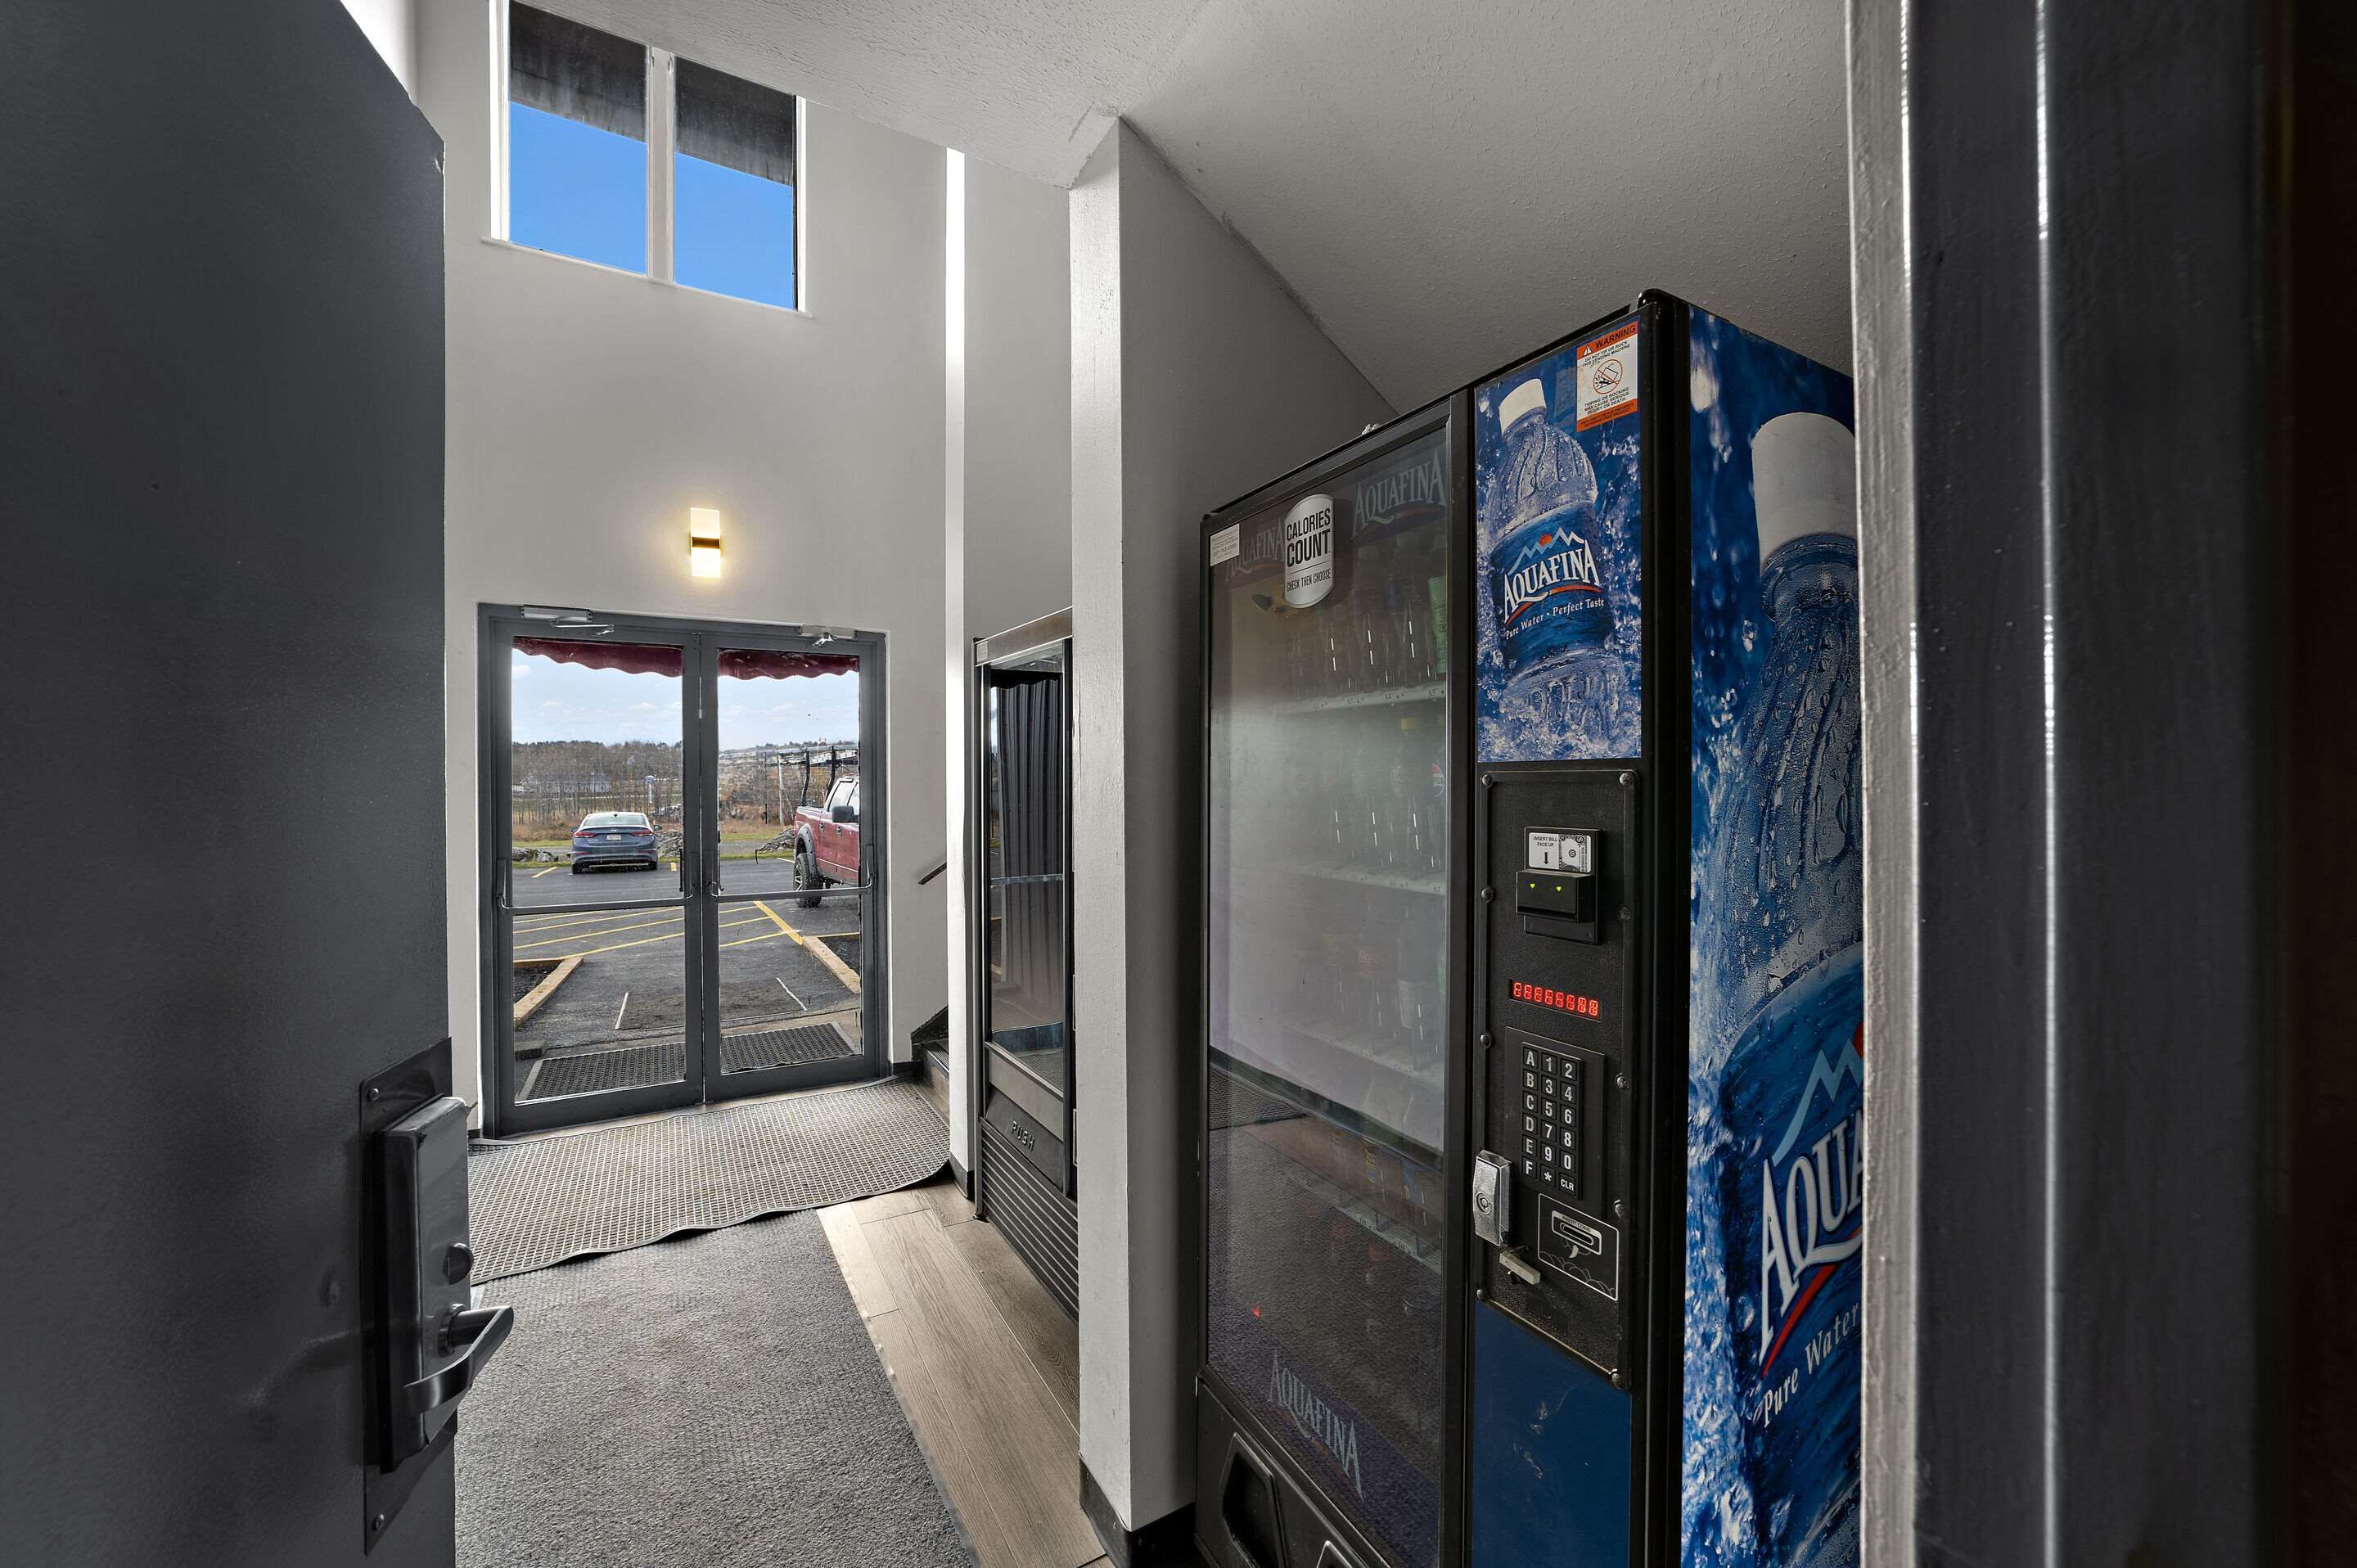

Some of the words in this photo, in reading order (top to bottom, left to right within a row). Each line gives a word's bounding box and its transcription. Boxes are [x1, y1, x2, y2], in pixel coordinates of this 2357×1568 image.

[1595, 324, 1636, 349] WARNING
[1615, 340, 1628, 349] ROCK
[1592, 352, 1611, 364] VENDING
[1611, 344, 1630, 355] MACHINE
[1584, 397, 1601, 408] TIPPING
[1608, 386, 1629, 399] ROCKING
[1593, 399, 1609, 408] CAUSE
[1610, 390, 1629, 402] SERIOUS
[1610, 397, 1626, 406] DEATH
[1352, 447, 1448, 538] AQUAFINA
[1287, 507, 1331, 542] CALORIES
[1287, 579, 1300, 592] CHECK
[1301, 574, 1312, 588] THEN
[1313, 568, 1331, 583] CHOOSE
[1504, 539, 1601, 624] AQUAFINA
[1506, 628, 1519, 640] Pure
[1521, 614, 1544, 630] Water
[1552, 602, 1583, 616] Perfect
[1584, 598, 1604, 609] Taste
[1526, 1051, 1535, 1067] A
[1545, 1057, 1552, 1072] 1
[1565, 1062, 1573, 1079] 2
[1526, 1072, 1535, 1088] B
[1545, 1079, 1553, 1094] 3
[1564, 1086, 1573, 1102] 4
[1526, 1094, 1535, 1110] C
[1545, 1101, 1553, 1117] 5
[1564, 1108, 1572, 1124] 6
[1010, 1120, 1035, 1152] PUSH
[1526, 1116, 1535, 1132] D
[1544, 1123, 1553, 1139] 7
[1564, 1131, 1572, 1147] 8
[1526, 1138, 1533, 1154] E
[1544, 1146, 1553, 1162] 9
[1563, 1154, 1571, 1170] 0
[1526, 1160, 1533, 1175] F
[1560, 1178, 1575, 1192] CLR
[1764, 1367, 1799, 1430] Pure
[1805, 1302, 1859, 1376] Water
[1268, 1348, 1363, 1501] AQUAFINA
